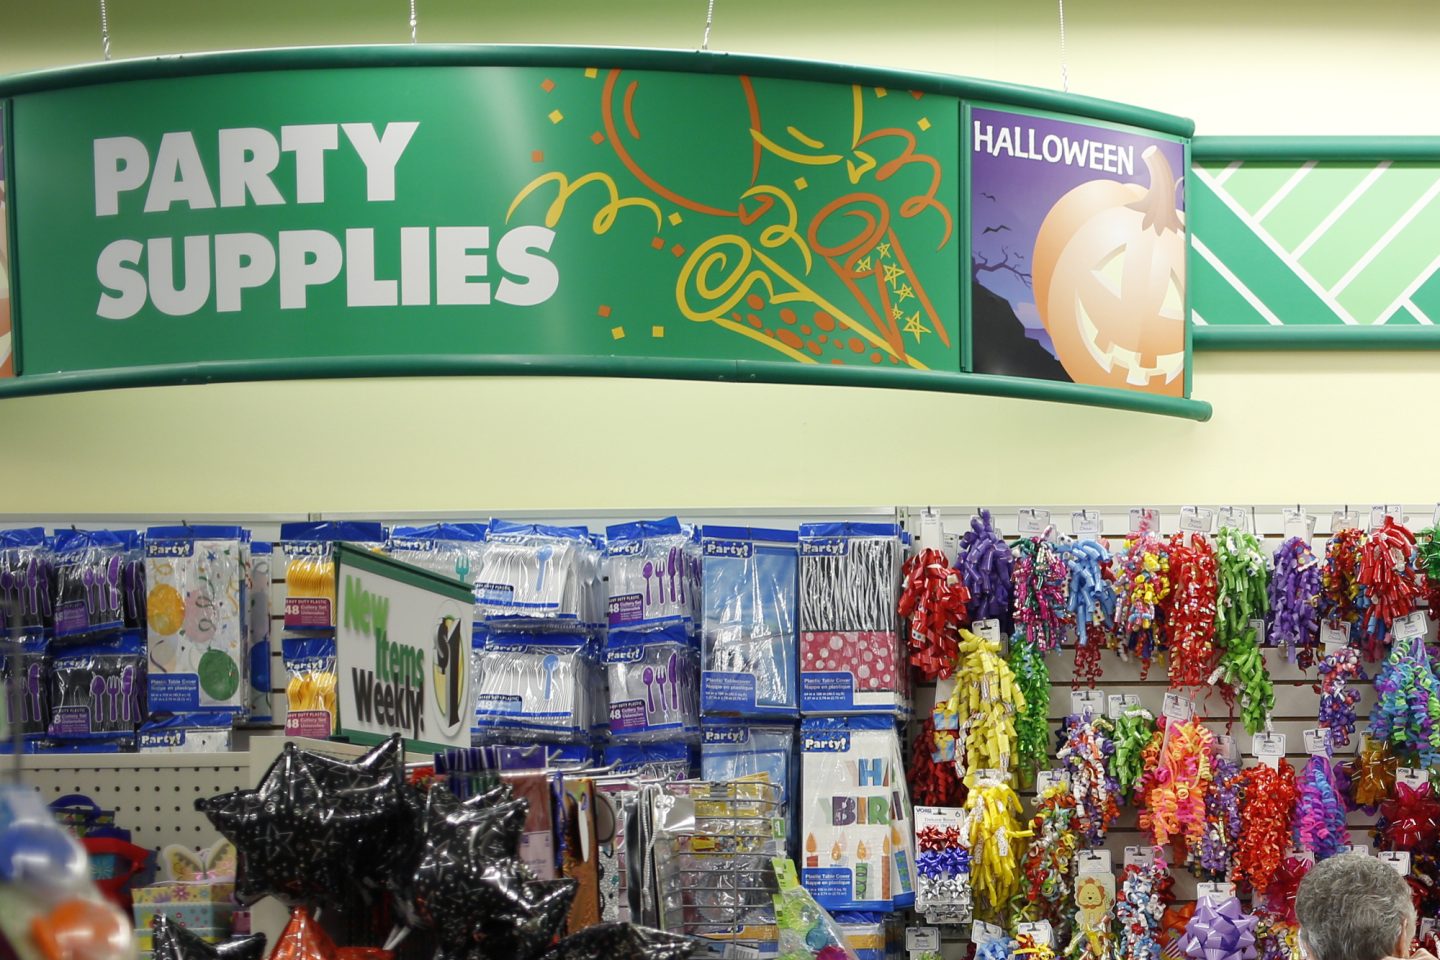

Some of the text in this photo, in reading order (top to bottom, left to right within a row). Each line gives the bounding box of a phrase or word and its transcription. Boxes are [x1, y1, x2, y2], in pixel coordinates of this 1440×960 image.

[974, 120, 1135, 176] HALLOWEEN
[94, 121, 421, 216] PARTY
[95, 225, 560, 320] SUPPLIES
[149, 543, 191, 556] Party!
[706, 542, 749, 556] Party!
[802, 541, 845, 555] Party!
[284, 605, 300, 615] 48
[344, 575, 389, 634] New
[609, 602, 619, 612] 48
[376, 628, 425, 688] Items
[436, 617, 461, 728] $1
[352, 667, 425, 740] Weekly!
[610, 709, 621, 720] 48
[287, 718, 299, 729] 48
[141, 732, 182, 746] Party!
[706, 729, 745, 742] Party!
[805, 736, 847, 750] Party!
